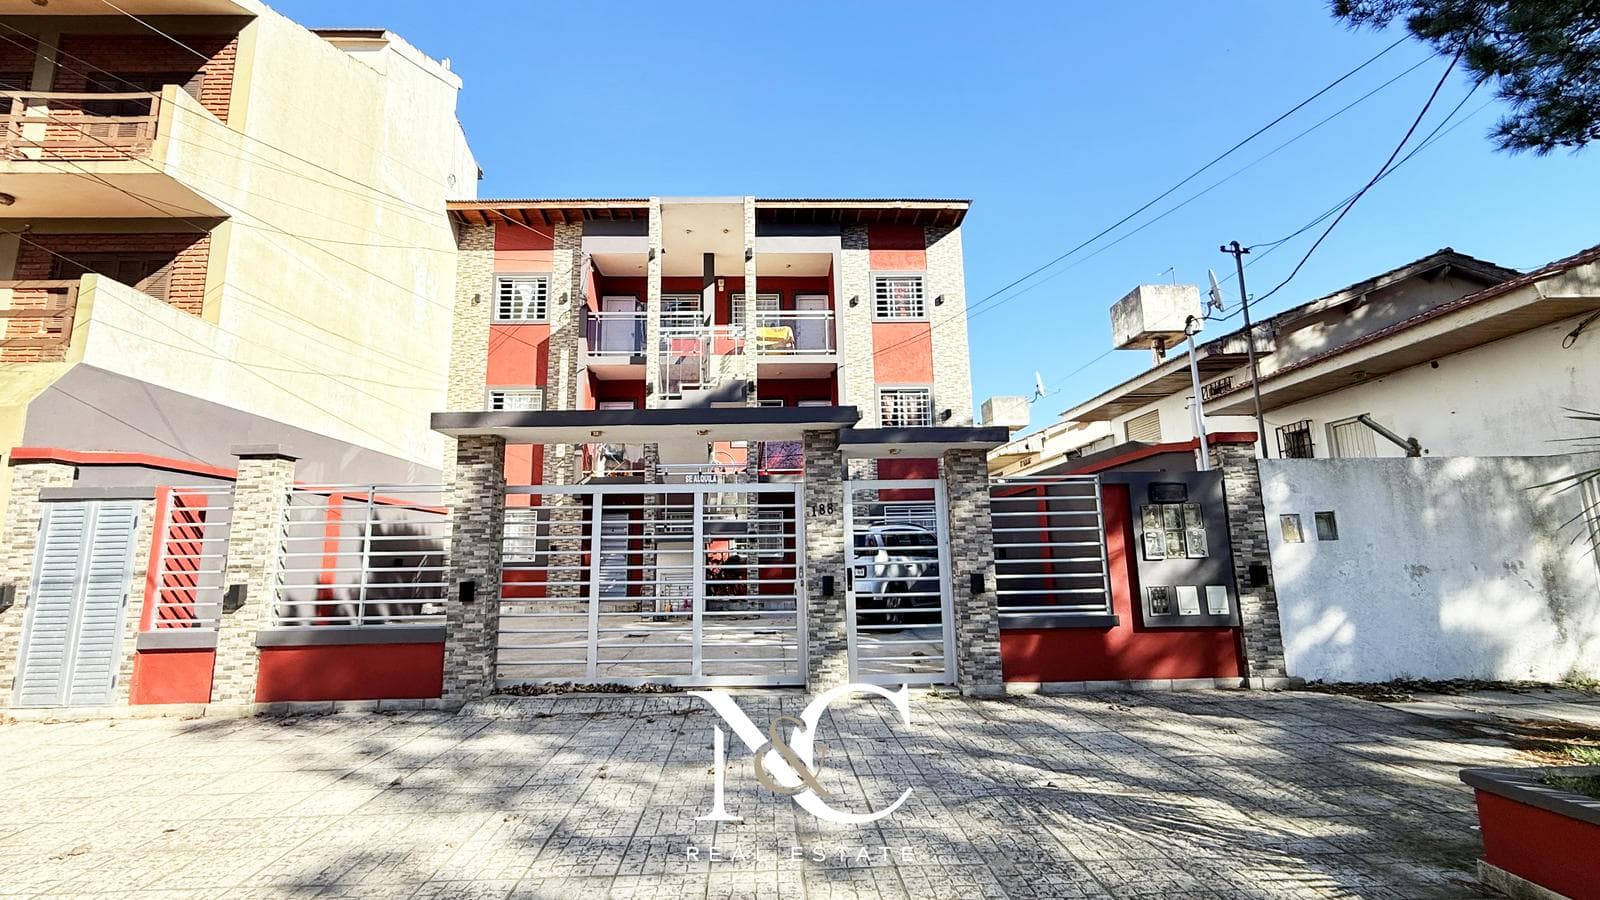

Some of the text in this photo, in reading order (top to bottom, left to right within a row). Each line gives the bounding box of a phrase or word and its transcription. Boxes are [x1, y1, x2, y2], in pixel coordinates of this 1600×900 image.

[685, 475, 717, 483] SE ALQUILA
[812, 503, 834, 517] 188
